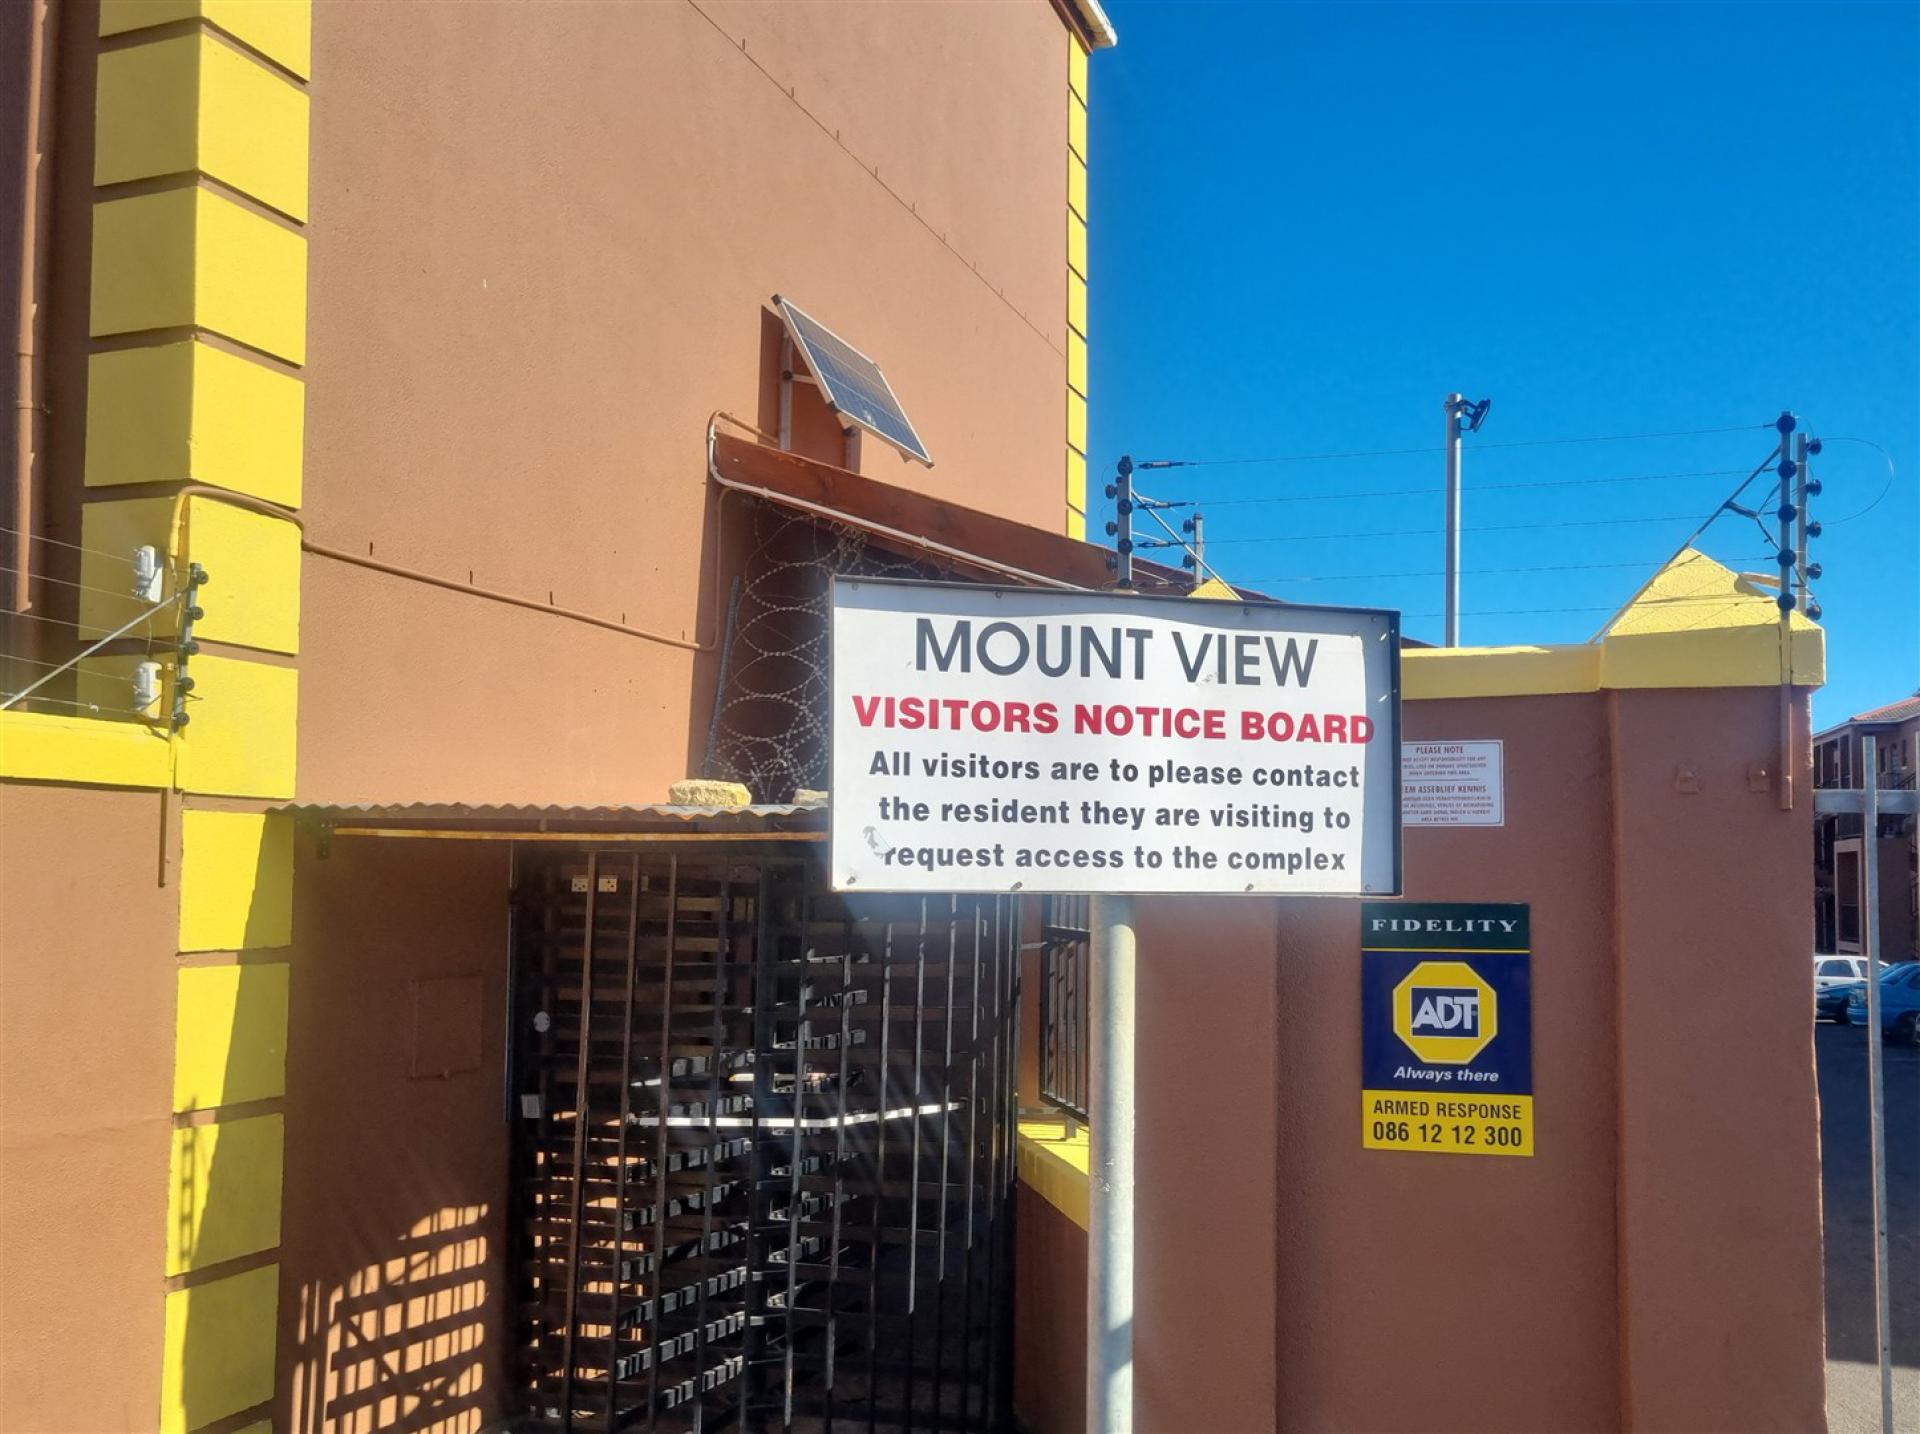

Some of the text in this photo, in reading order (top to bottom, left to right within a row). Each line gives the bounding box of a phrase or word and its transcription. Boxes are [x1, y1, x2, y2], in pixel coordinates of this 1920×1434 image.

[915, 617, 1318, 688] MOUNT VIEW
[852, 695, 1374, 745] VISITORS NOTICE BOARD
[869, 751, 1359, 788] All visitors are to please contact
[879, 796, 1351, 834] the resident they are visiting to
[884, 842, 1345, 874] request access to the complex
[1372, 919, 1517, 932] FIDELITY
[1411, 996, 1478, 1029] ADT
[1394, 1067, 1499, 1083] Always there
[1373, 1100, 1522, 1119] ARMED RESPONSE
[1373, 1122, 1522, 1146] 086 12 12 300
